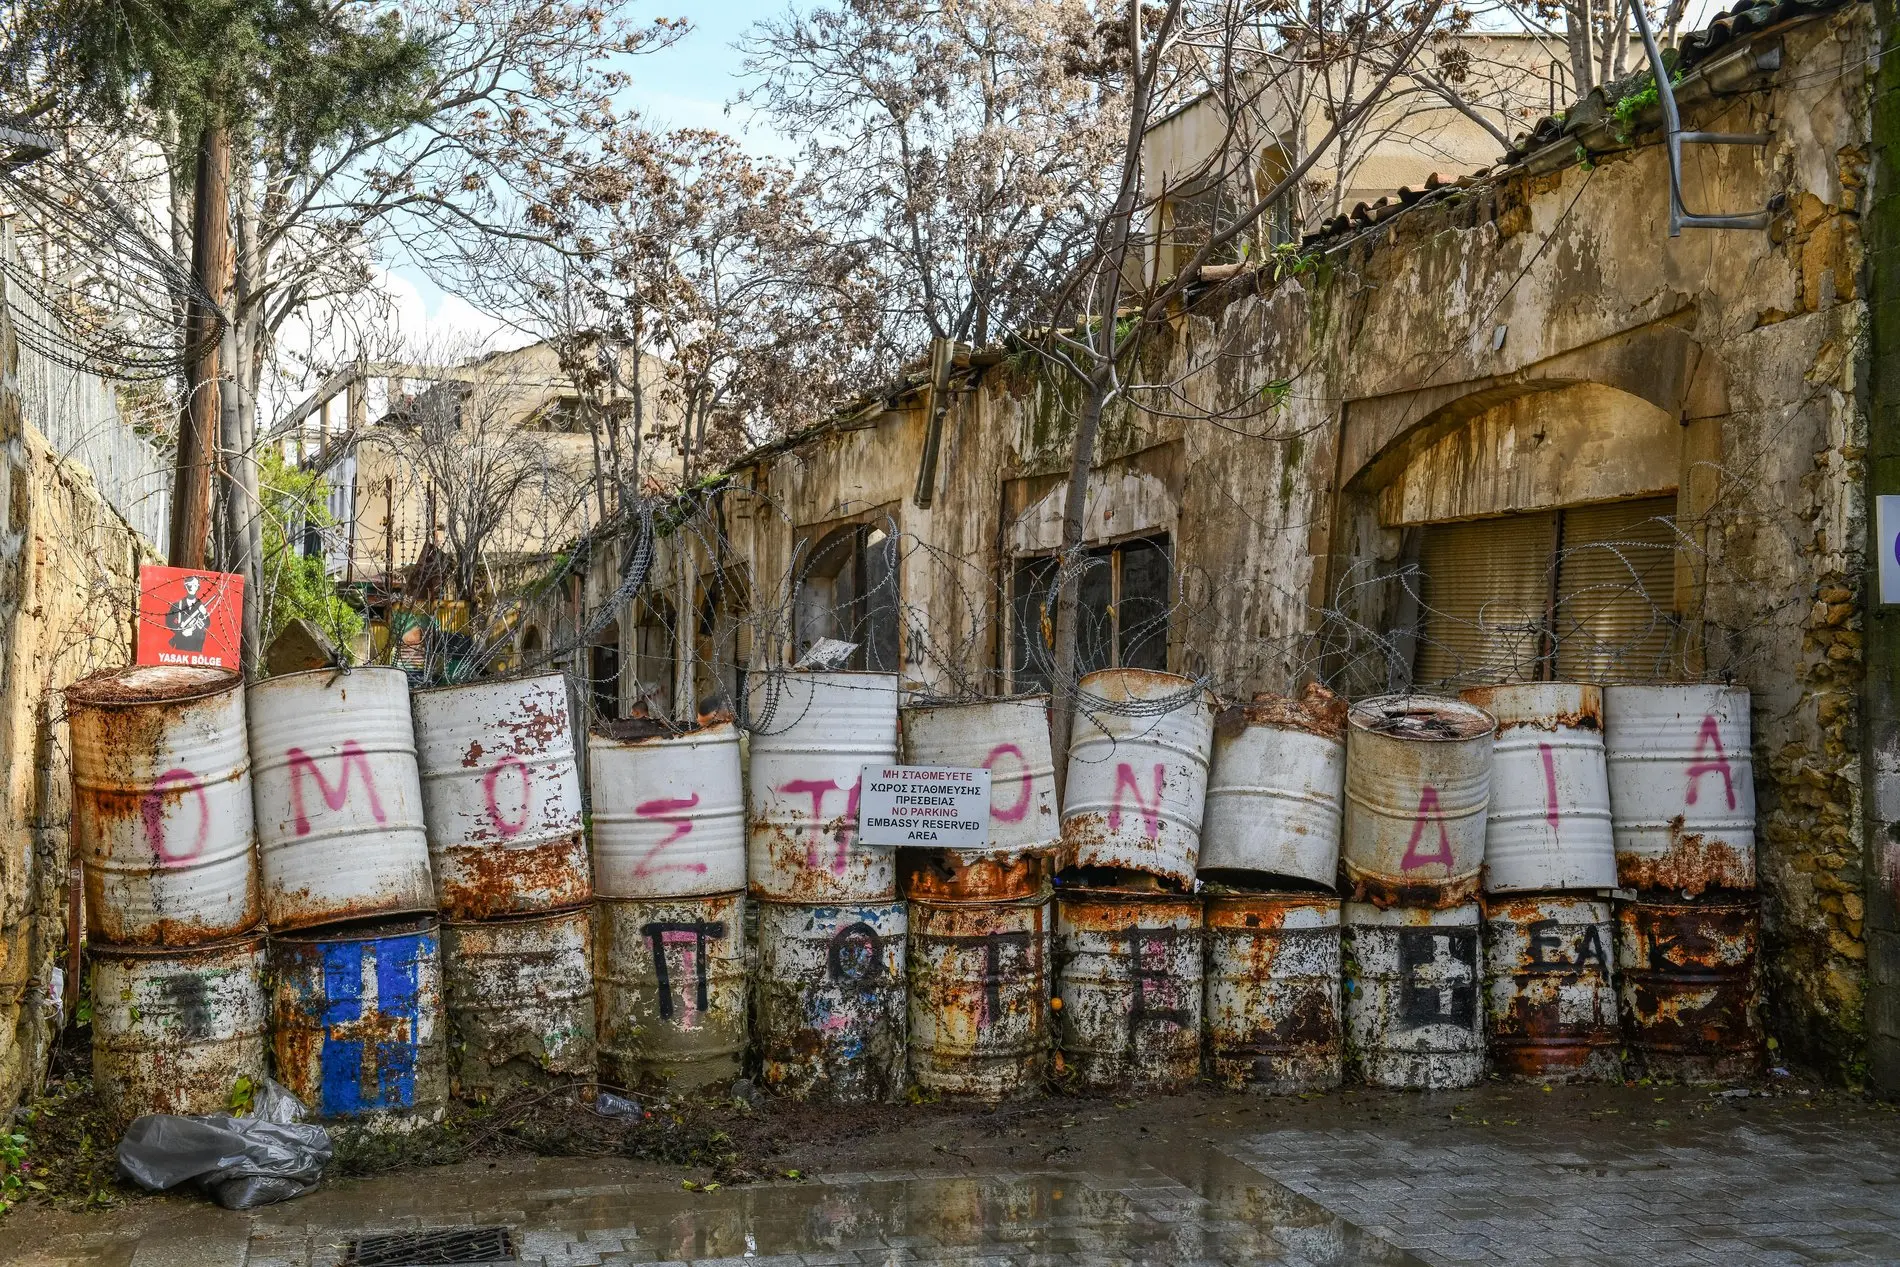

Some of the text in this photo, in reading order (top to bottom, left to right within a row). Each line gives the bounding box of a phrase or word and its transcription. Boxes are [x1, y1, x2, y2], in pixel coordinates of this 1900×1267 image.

[158, 653, 221, 666] YASAK BÖLGE
[882, 770, 973, 781] ΜΗ ΣΤΑΘΜΕΥΕΤΕ
[870, 783, 981, 796] ΧΩΡΟΣ ΣΤΑΘΜΕΥΣΗΣ
[895, 795, 955, 806] ΠΡΕΣΒΕΙΑΣ
[891, 807, 958, 818] NO PARKING
[867, 818, 980, 831] EMBASSY RESERVED
[907, 831, 938, 841] AREA
